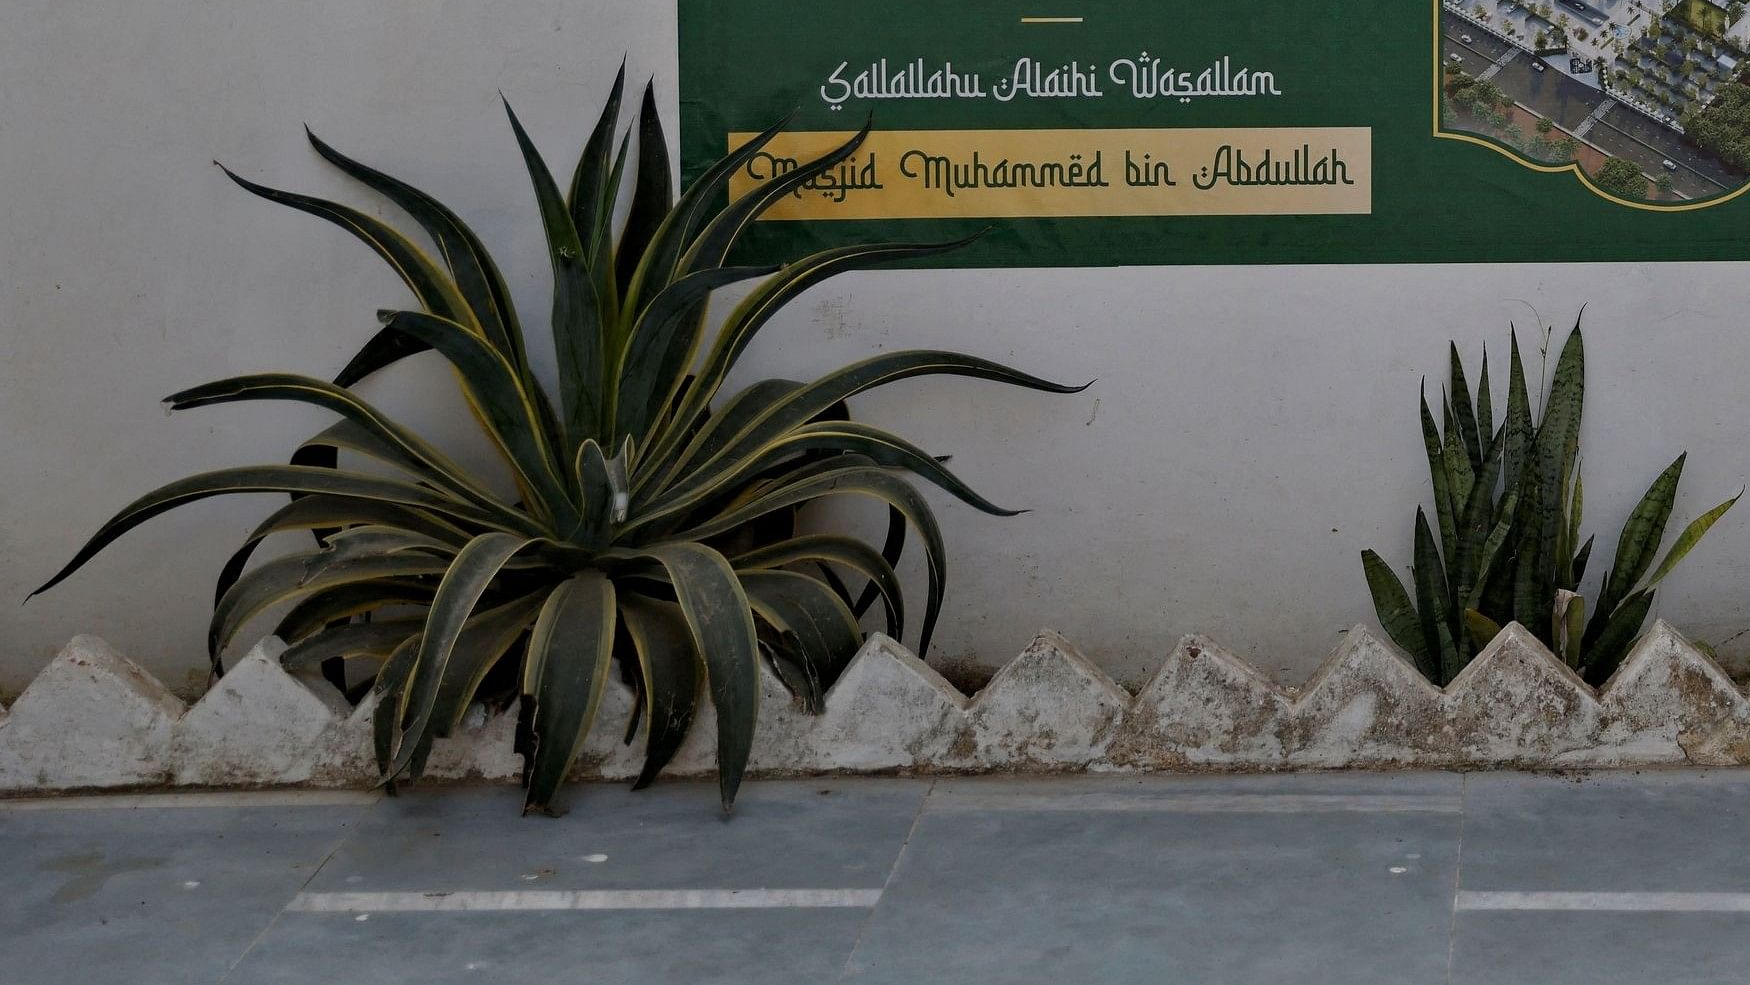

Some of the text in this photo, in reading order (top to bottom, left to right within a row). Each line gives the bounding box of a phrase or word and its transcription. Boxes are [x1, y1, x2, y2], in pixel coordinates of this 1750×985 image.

[820, 57, 987, 112] Sallallahu
[993, 56, 1104, 102] Alaihi
[1125, 148, 1177, 188] bin
[1192, 144, 1355, 192] Abdullah
